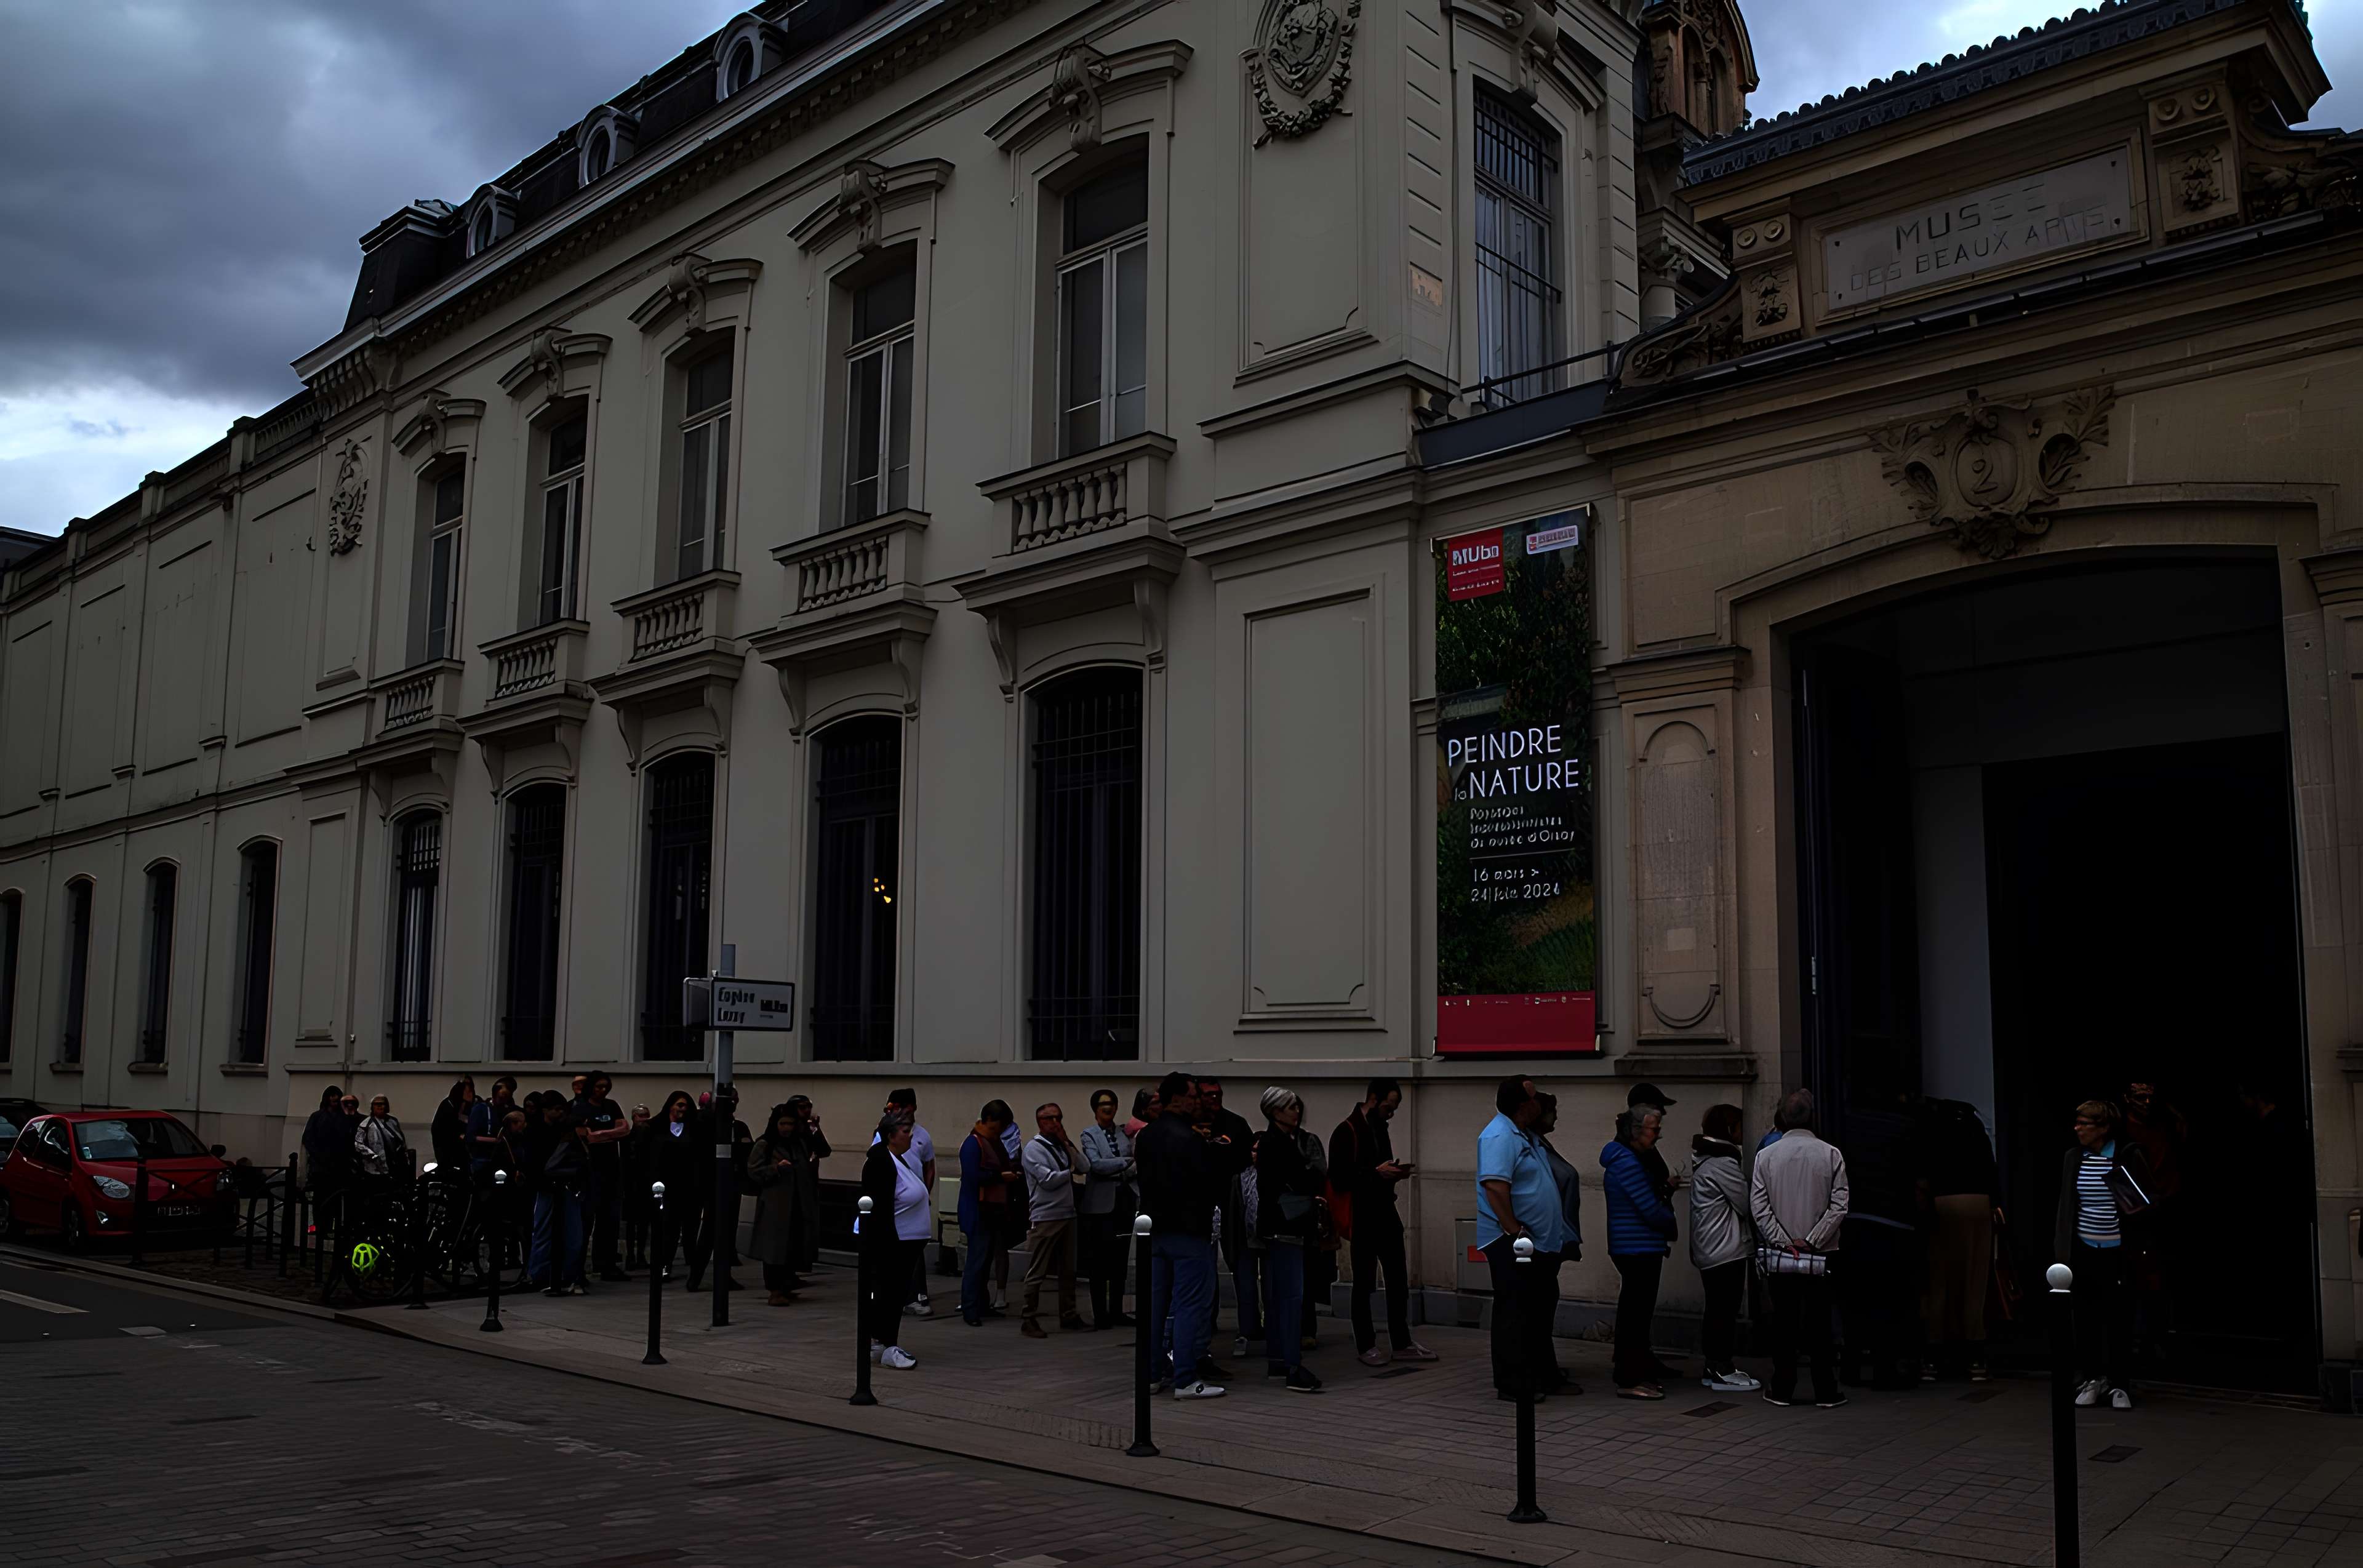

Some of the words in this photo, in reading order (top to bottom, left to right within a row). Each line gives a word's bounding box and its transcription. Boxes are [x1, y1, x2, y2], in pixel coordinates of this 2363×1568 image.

[1916, 231, 2009, 274] BEAUX
[1448, 724, 1561, 768] PEINDRE
[1469, 758, 1580, 799] NATURE
[1474, 868, 1489, 882] 16
